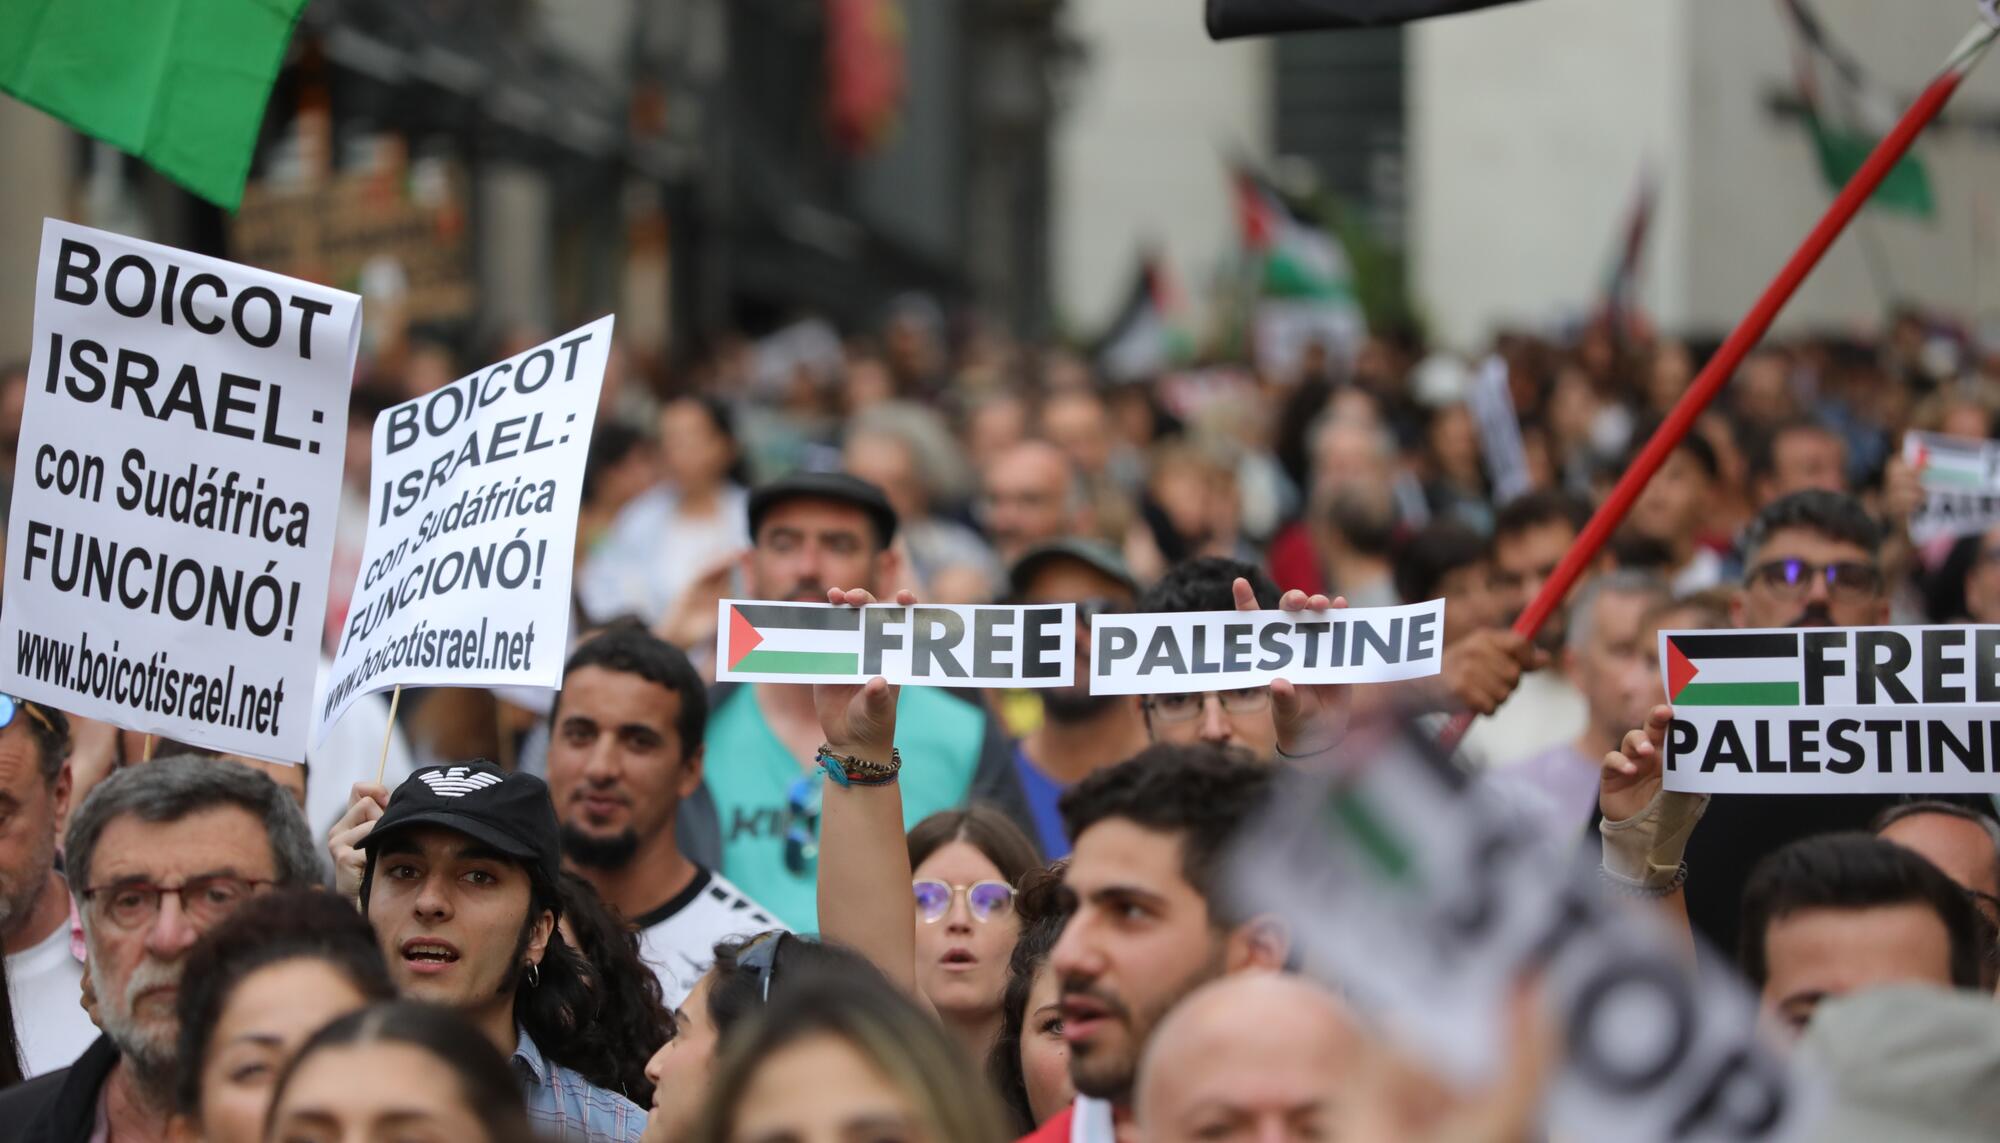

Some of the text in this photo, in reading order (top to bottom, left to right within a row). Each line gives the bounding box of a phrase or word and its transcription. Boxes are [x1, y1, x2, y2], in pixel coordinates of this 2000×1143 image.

[54, 238, 332, 360] BOICOT
[46, 333, 325, 454] ISRAEL:
[385, 334, 592, 454] BOICOT
[35, 444, 310, 548] con Sudáfrica
[379, 413, 575, 526] ISRAEL:
[23, 520, 300, 642] FUNCIONÓ!
[364, 476, 556, 590] con Sudáfrica
[341, 528, 548, 657] FUNCIONÓ!
[863, 608, 1062, 678] FREE
[1098, 612, 1436, 676] PALESTINE
[17, 630, 284, 736] www.boicotisrael.net
[324, 616, 535, 722] www.boicotisrael.net
